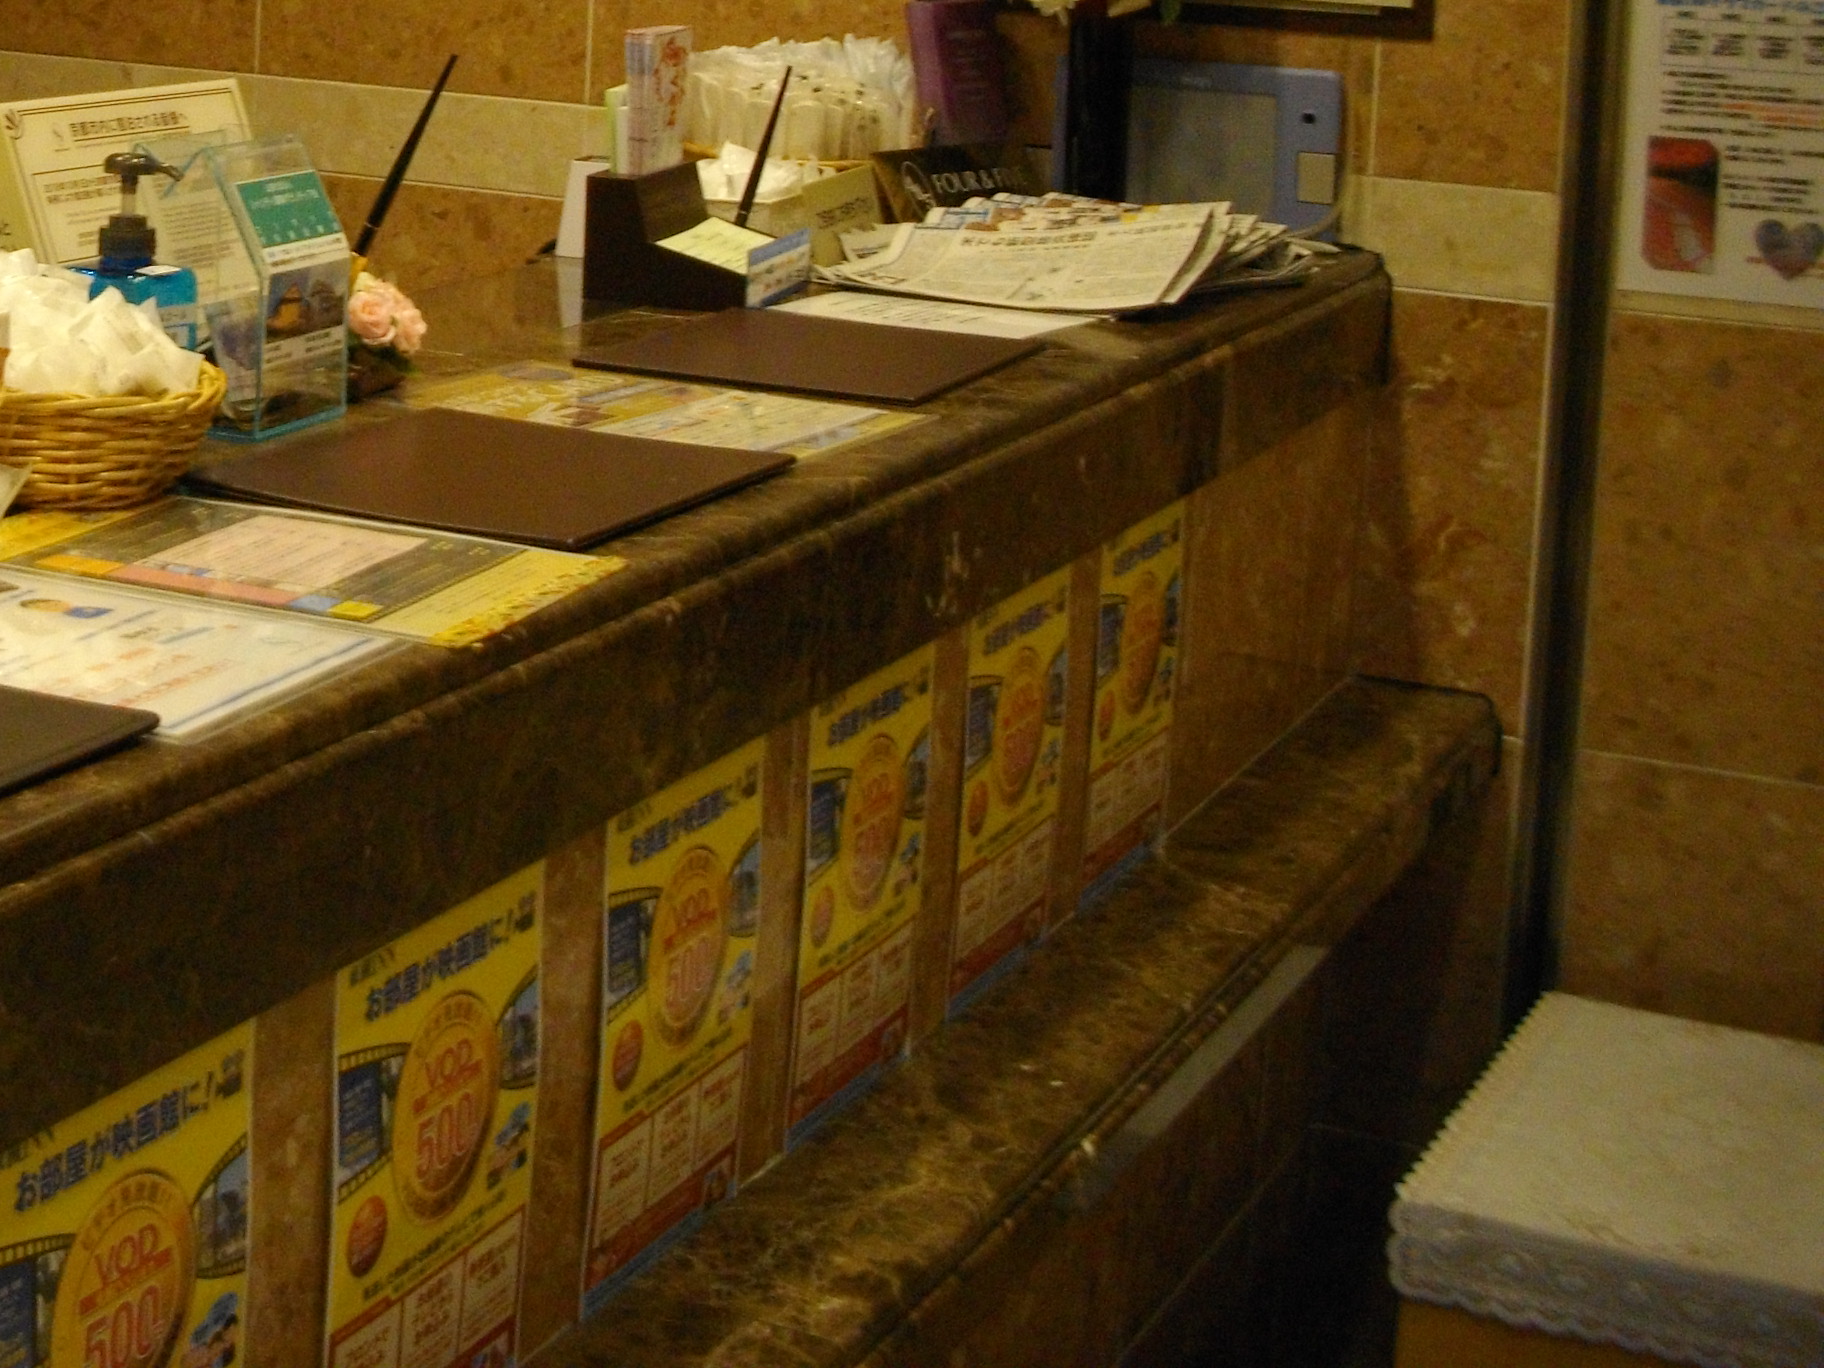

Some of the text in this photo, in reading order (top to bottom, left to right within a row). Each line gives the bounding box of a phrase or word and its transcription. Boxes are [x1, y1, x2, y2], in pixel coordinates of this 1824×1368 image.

[16, 1065, 213, 1216] お部屋が映画館に!
[94, 1216, 159, 1293] VOD
